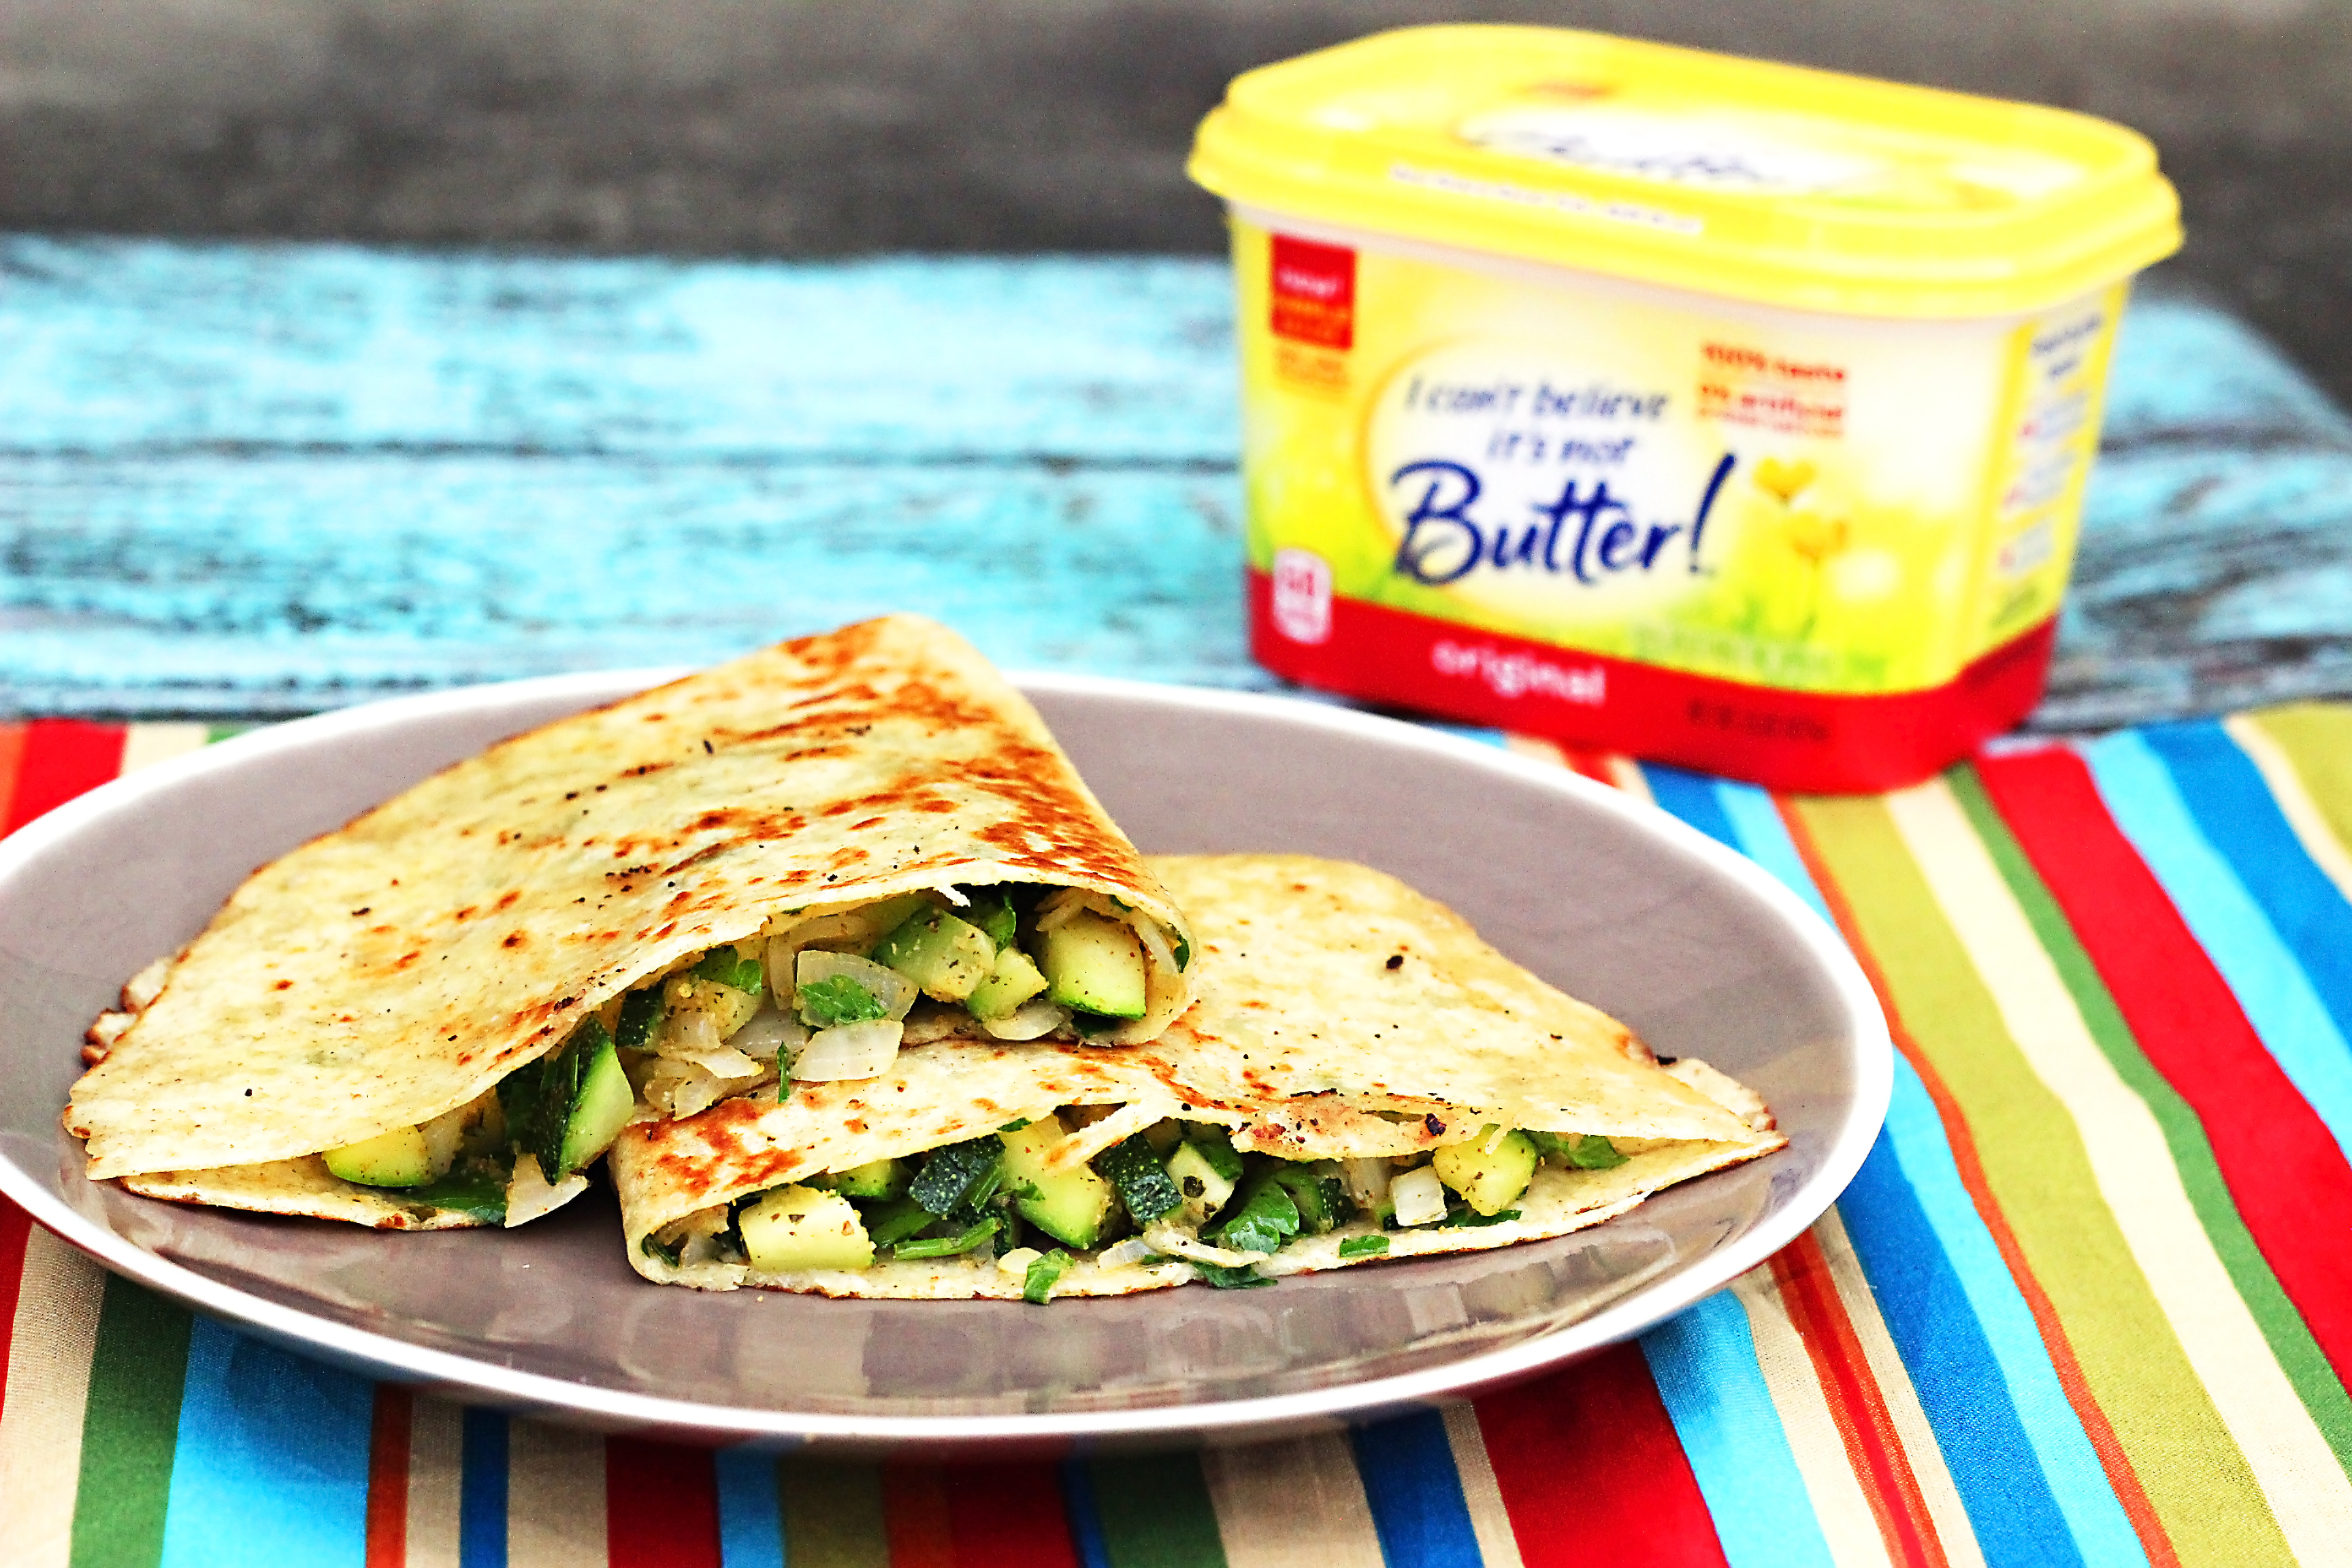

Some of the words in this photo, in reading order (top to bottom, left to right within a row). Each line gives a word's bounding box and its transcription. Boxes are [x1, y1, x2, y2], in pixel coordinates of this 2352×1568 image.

[1405, 373, 1424, 410] I
[1426, 380, 1523, 411] can't
[1533, 379, 1670, 419] believe
[1485, 429, 1548, 463] it's
[1561, 434, 1635, 463] not
[1390, 451, 1737, 588] Butter!
[1431, 637, 1609, 708] original
